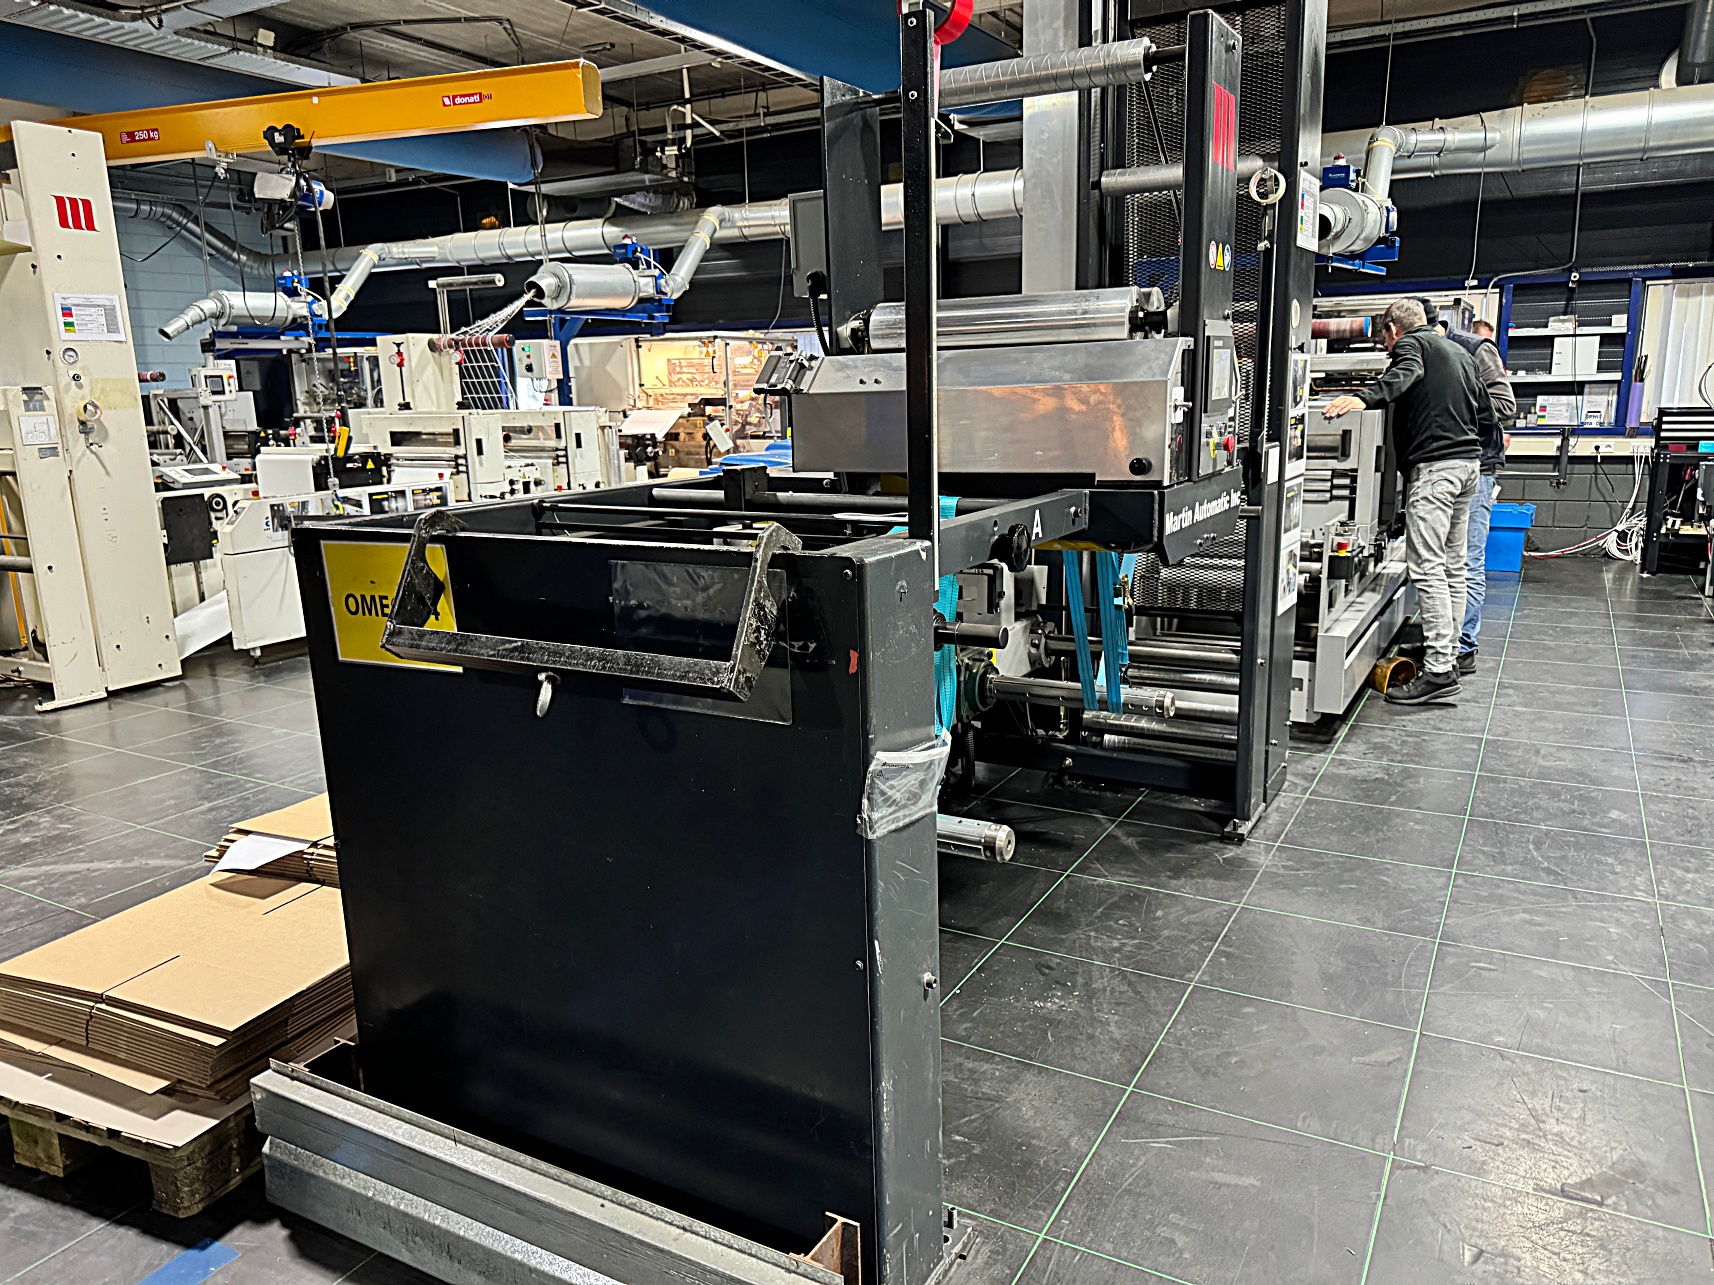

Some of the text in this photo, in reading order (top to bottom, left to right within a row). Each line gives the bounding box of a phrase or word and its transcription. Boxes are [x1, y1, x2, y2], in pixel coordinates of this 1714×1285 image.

[455, 94, 480, 105] donati
[134, 129, 159, 141] 250 kg
[1032, 509, 1043, 540] A
[1165, 505, 1193, 536] Martin
[1193, 491, 1230, 524] Automatic
[344, 592, 396, 618] OME
